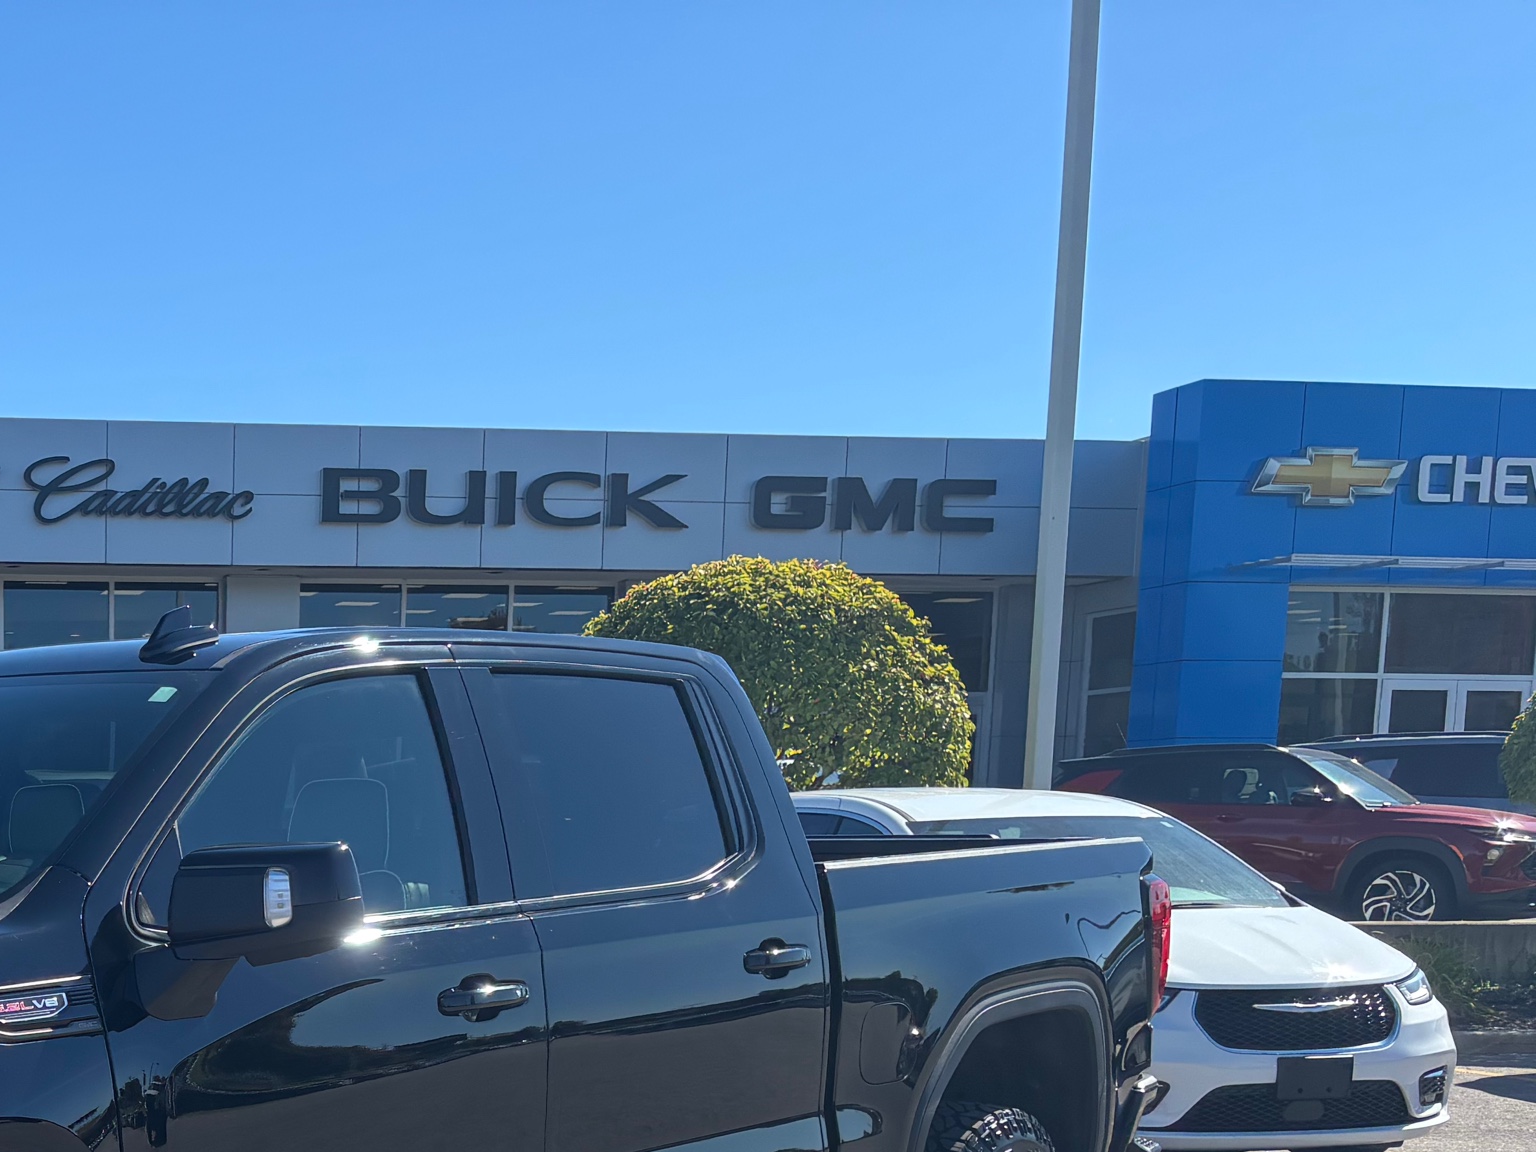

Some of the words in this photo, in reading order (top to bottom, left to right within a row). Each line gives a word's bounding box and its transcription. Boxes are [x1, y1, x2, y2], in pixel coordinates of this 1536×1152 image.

[23, 456, 254, 524] Cadillac
[320, 467, 689, 530] BUICK
[750, 475, 997, 533] GMC
[1418, 455, 1536, 504] CHE
